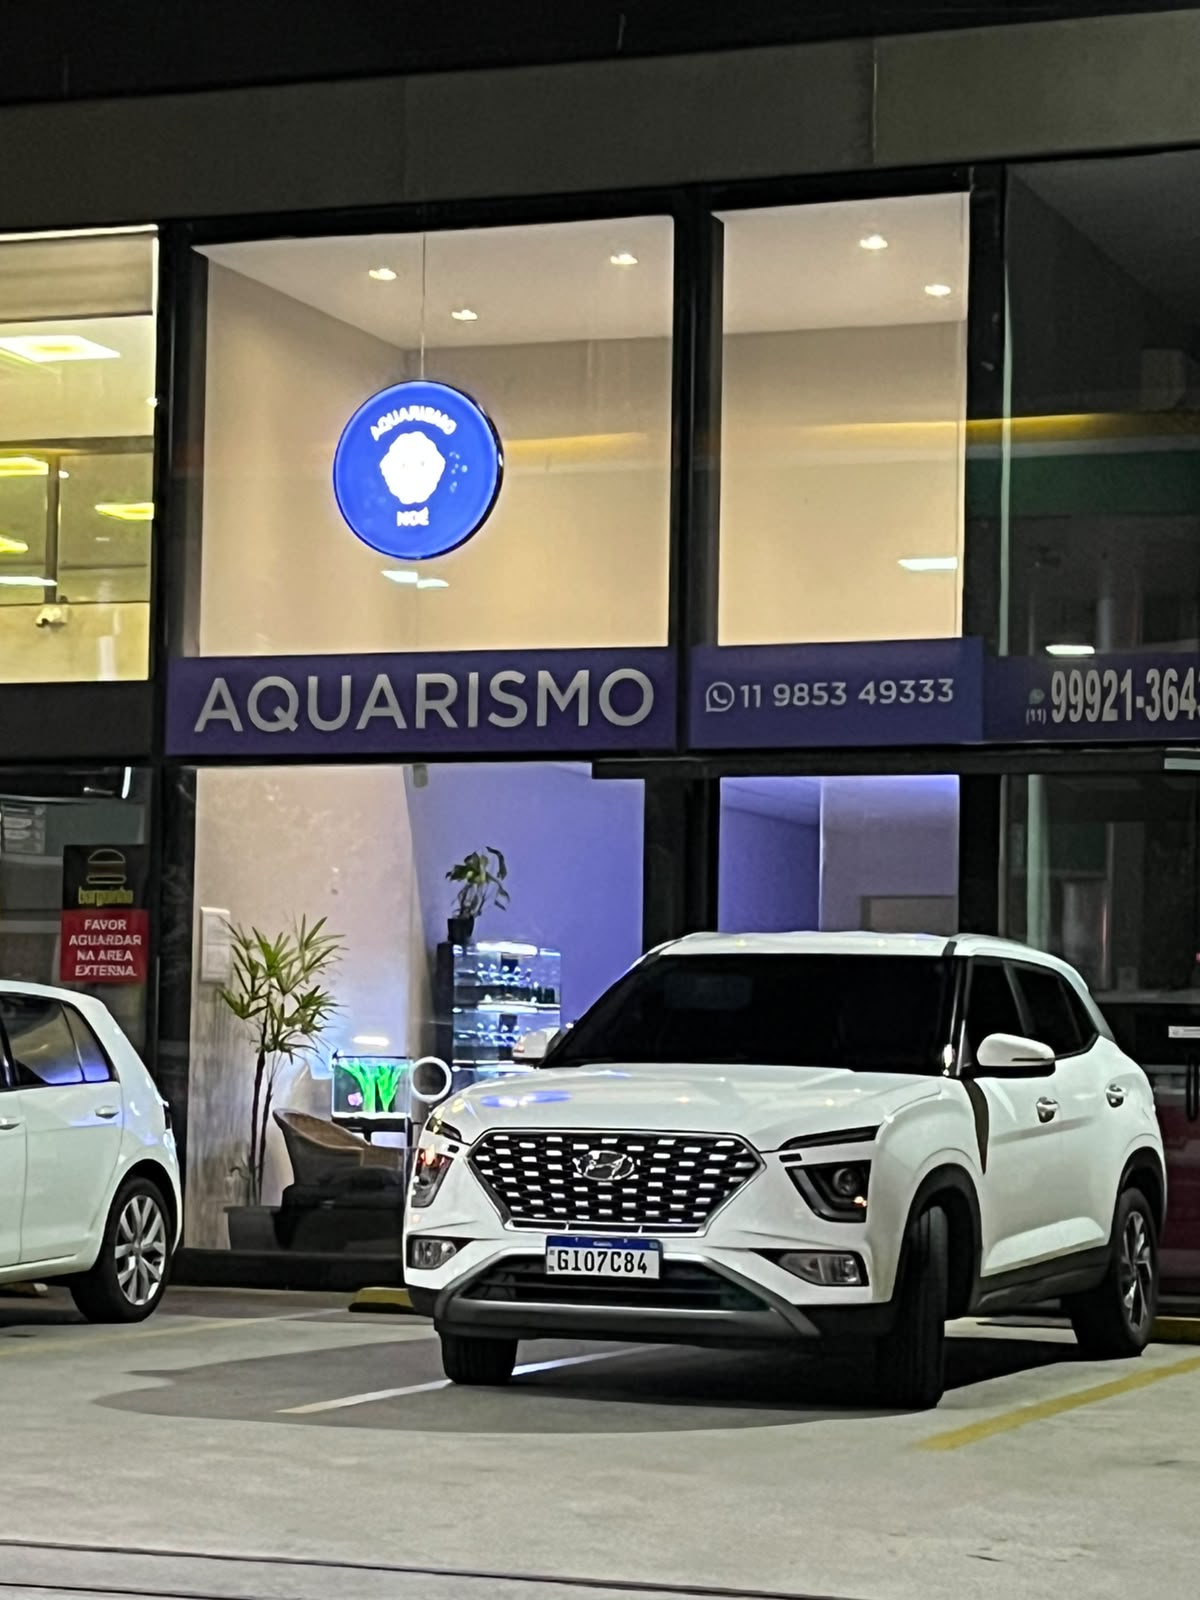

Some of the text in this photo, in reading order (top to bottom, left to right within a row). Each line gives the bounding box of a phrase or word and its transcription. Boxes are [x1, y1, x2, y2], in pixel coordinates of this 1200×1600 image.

[194, 668, 654, 732] AQUARISMO
[740, 678, 954, 708] 11 9853 49333
[1051, 667, 1200, 723] 99921-364
[84, 919, 127, 931] FAVOR
[69, 934, 142, 946] AGUARDAR
[77, 950, 95, 961] NA
